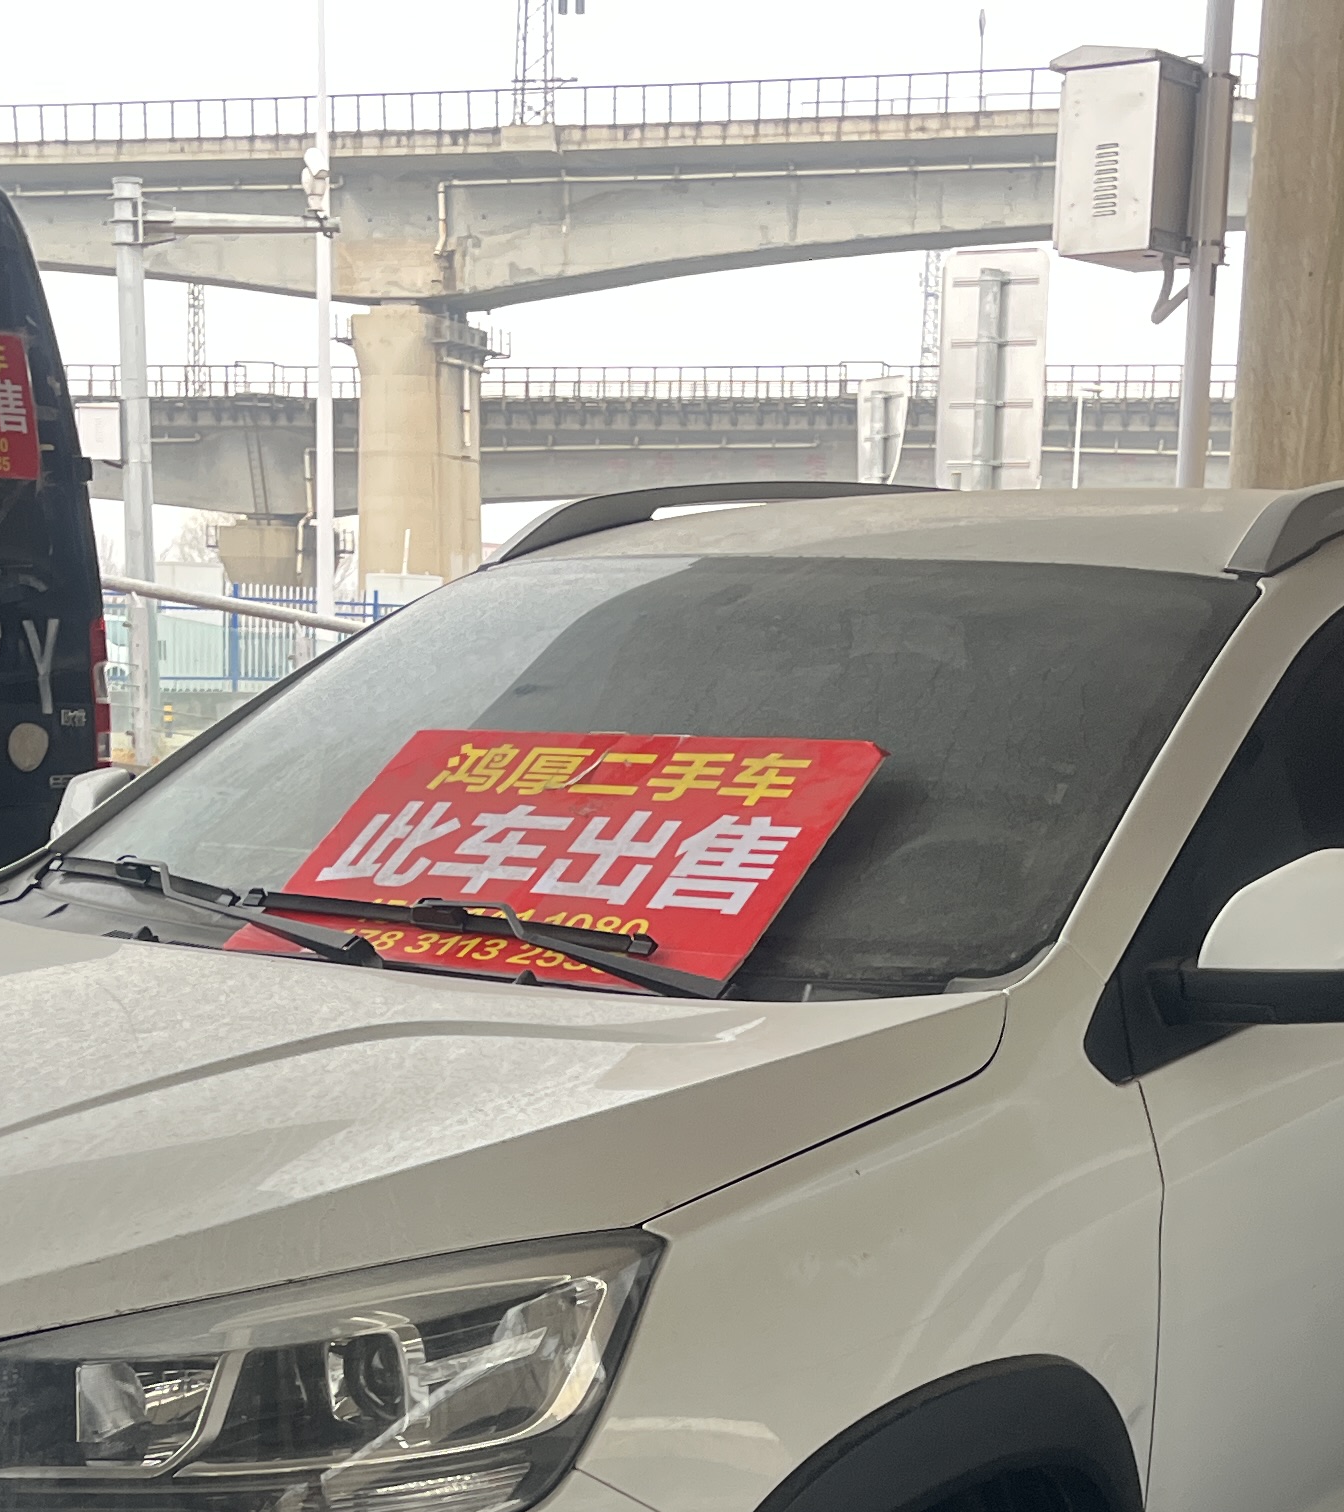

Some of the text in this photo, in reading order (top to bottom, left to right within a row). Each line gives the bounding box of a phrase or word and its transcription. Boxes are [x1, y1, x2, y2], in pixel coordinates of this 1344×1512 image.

[426, 743, 812, 806] 鸿厚二手车
[316, 800, 803, 915] 此车出售
[404, 933, 508, 960] 3113
